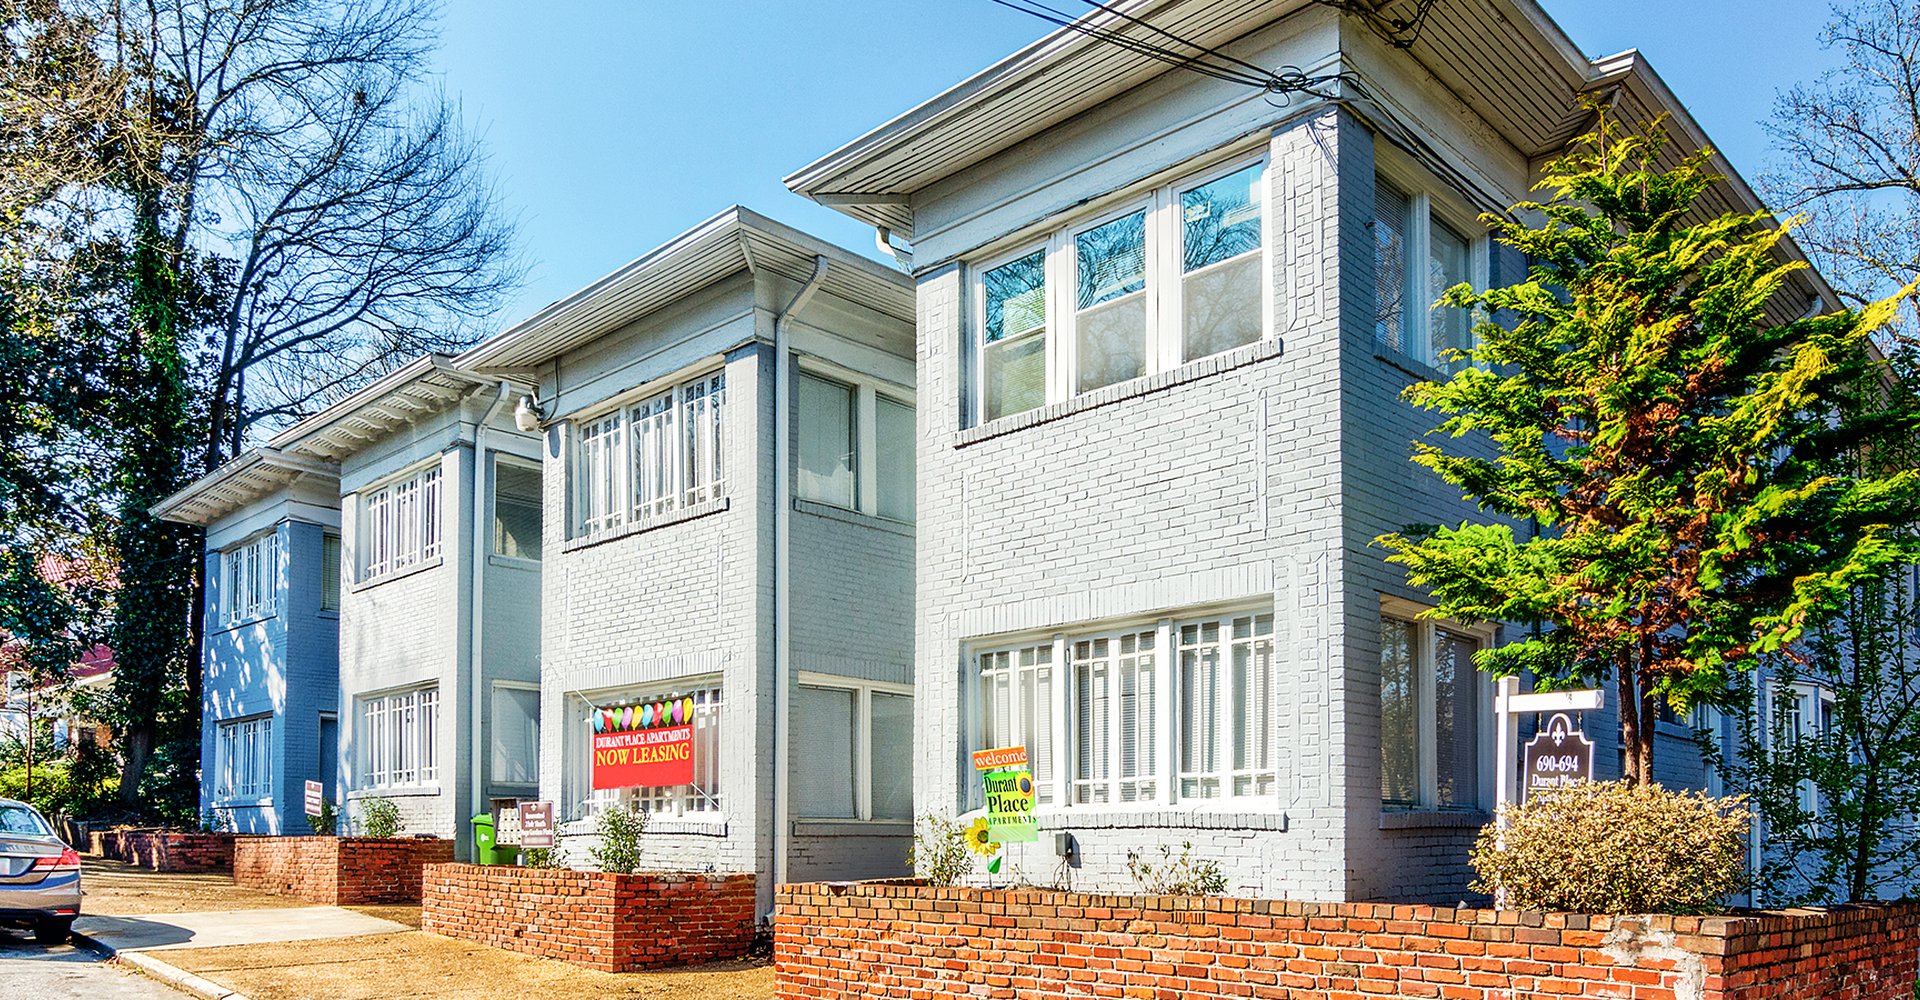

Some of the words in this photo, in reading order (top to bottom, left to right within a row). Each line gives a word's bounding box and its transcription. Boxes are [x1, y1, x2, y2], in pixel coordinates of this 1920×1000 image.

[596, 735, 624, 748] DURANT
[625, 733, 645, 746] PLACE
[646, 728, 690, 743] APARTMENTS
[596, 748, 630, 766] NOW
[632, 743, 690, 764] LEASING
[975, 751, 1027, 767] welcome
[1536, 755, 1578, 772] 690-694
[984, 777, 1017, 793] Durant
[988, 795, 1029, 813] Place
[988, 815, 1037, 825] APARTMENTS
